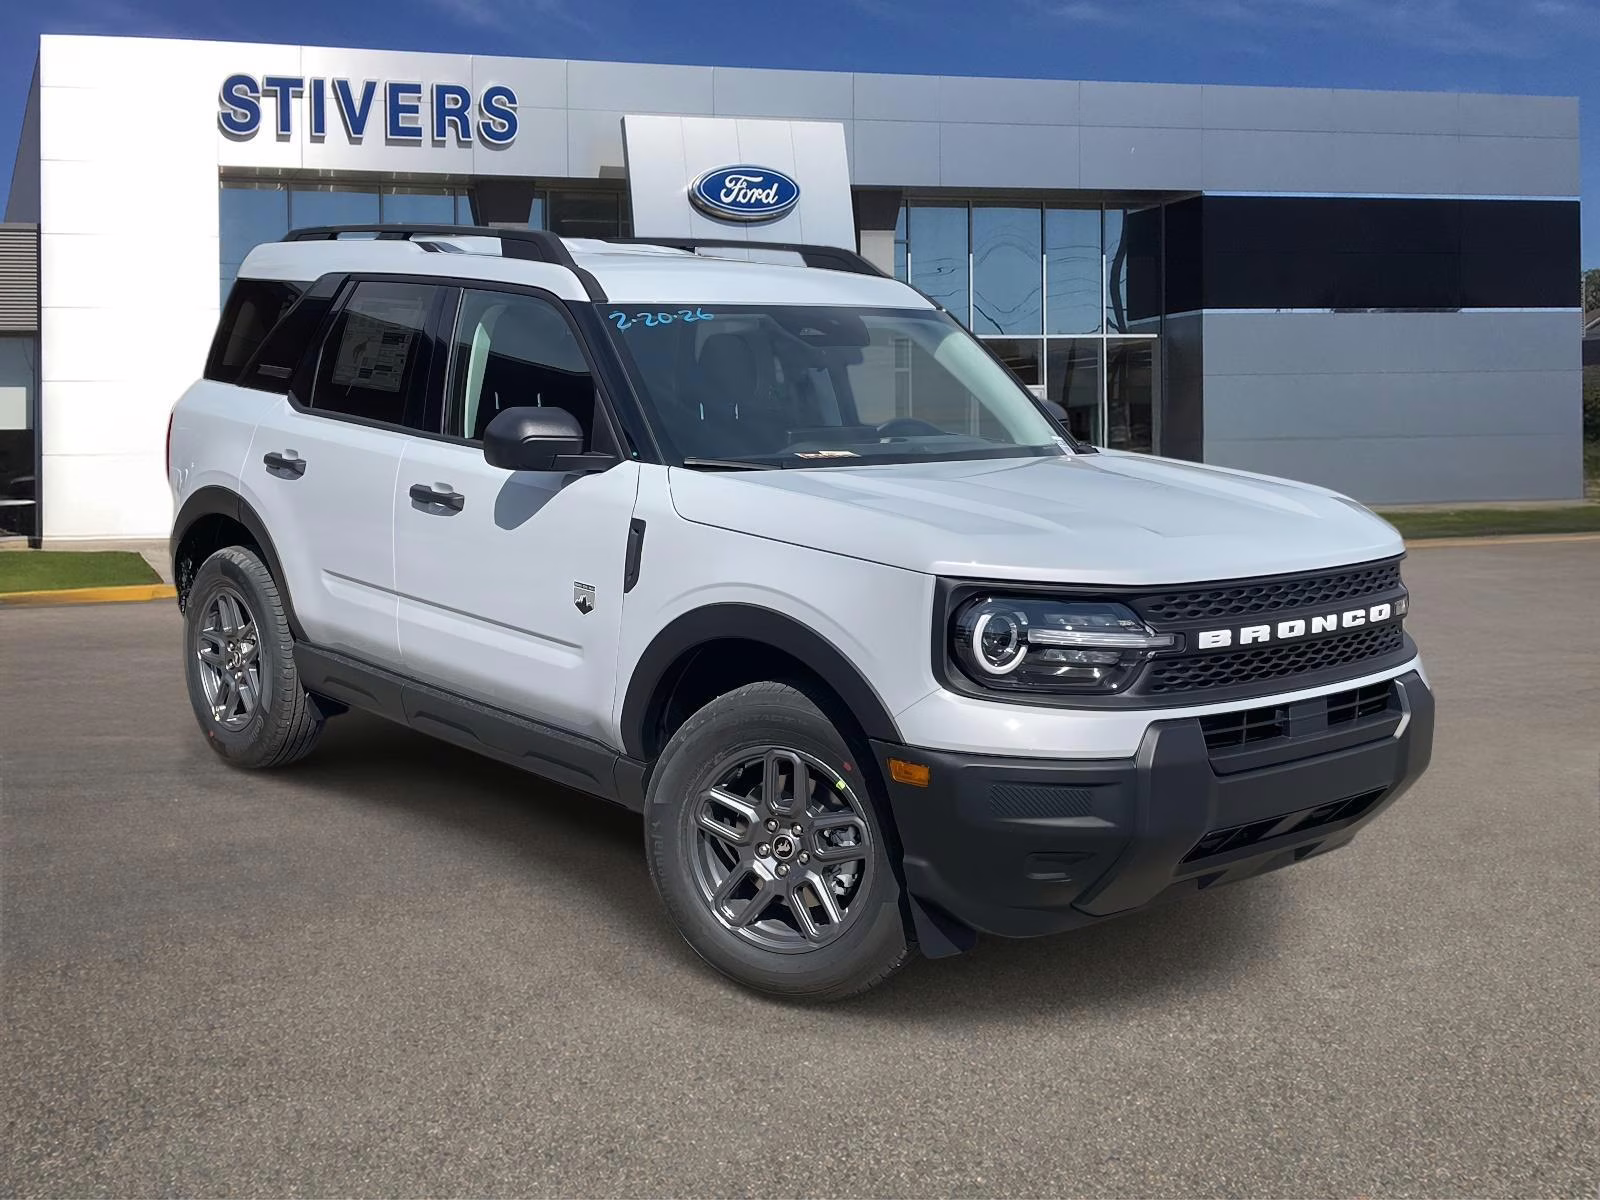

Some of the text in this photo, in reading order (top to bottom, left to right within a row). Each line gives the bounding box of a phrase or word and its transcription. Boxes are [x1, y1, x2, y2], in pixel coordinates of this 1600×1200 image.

[218, 73, 519, 146] STIVERS
[720, 174, 779, 204] Ford
[1198, 603, 1391, 650] BRONCO
